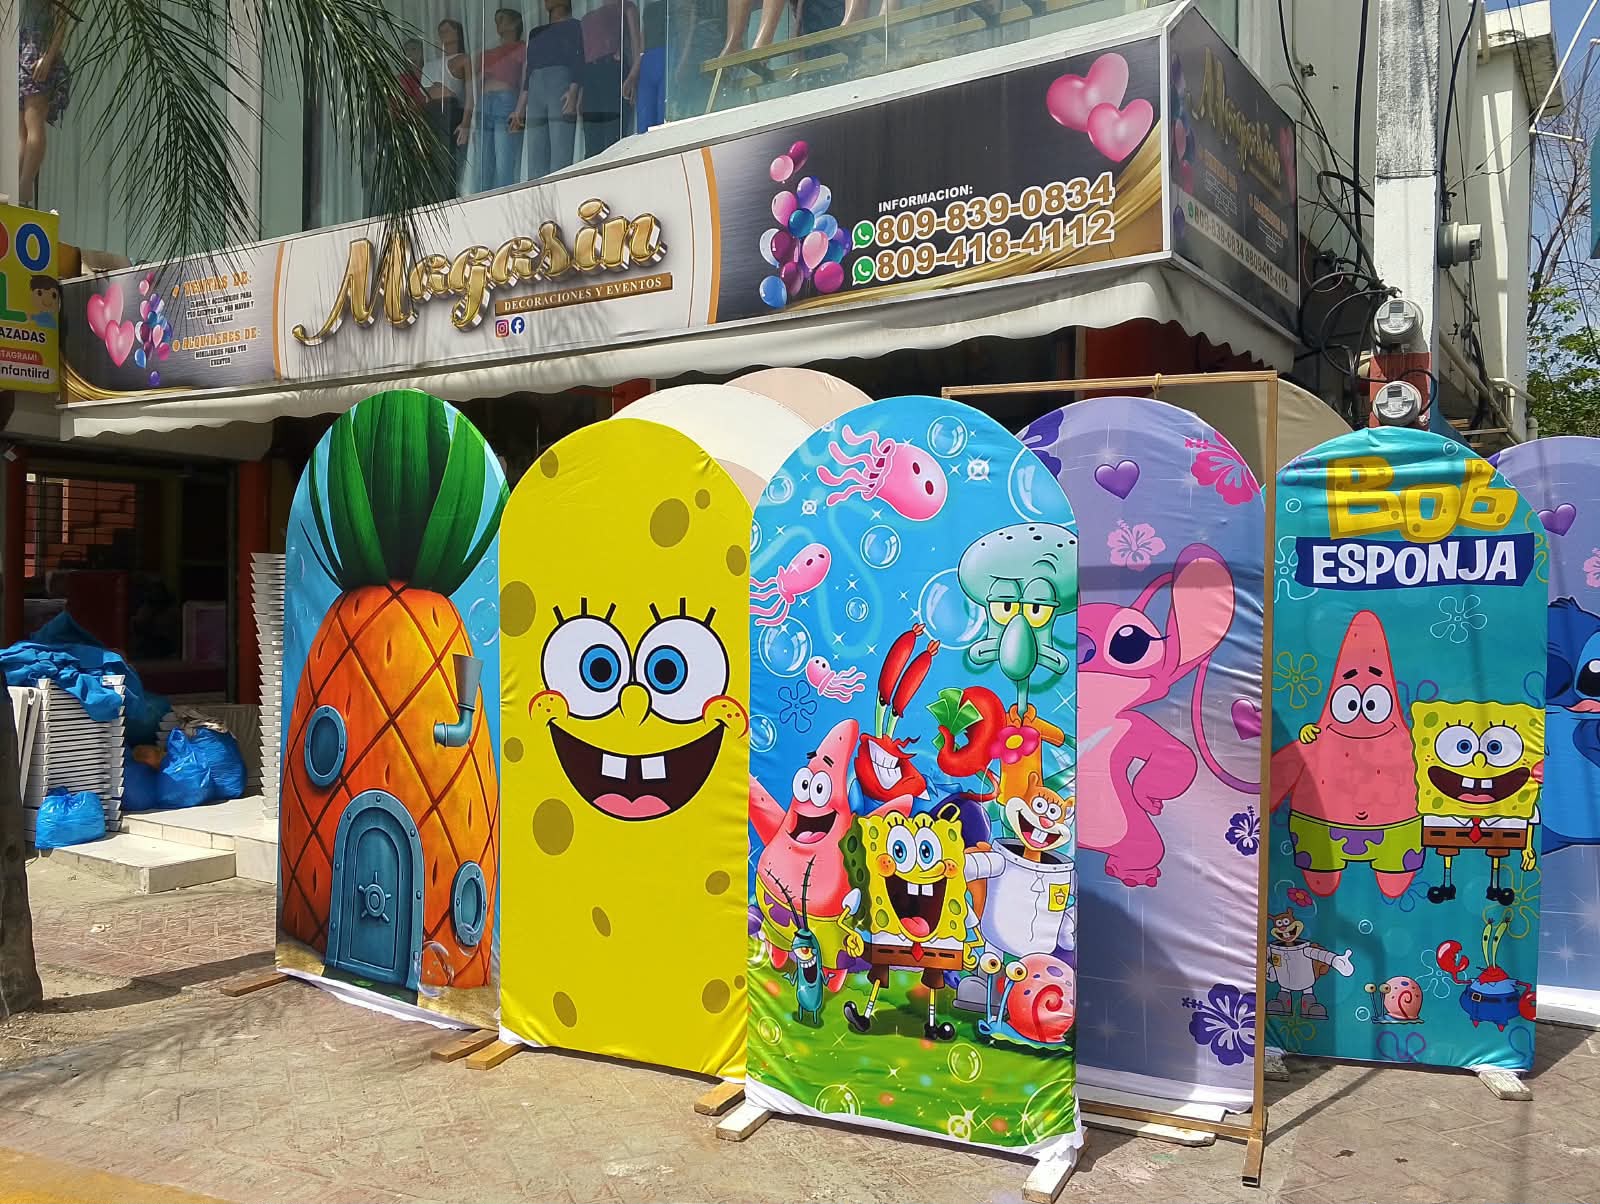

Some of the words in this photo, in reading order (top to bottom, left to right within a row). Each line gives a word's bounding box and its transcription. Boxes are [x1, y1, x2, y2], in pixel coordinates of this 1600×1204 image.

[876, 172, 1115, 246] 809-839-0834
[878, 184, 974, 213] INFORMACION:
[876, 210, 1115, 281] 809-418-4112
[292, 198, 669, 346] Magasin
[504, 288, 592, 312] DECORACIONES
[594, 286, 602, 297] Y
[606, 276, 663, 296] EVENTOS
[183, 329, 241, 350] ALQUILERES
[1312, 539, 1517, 586] ESPONJA
